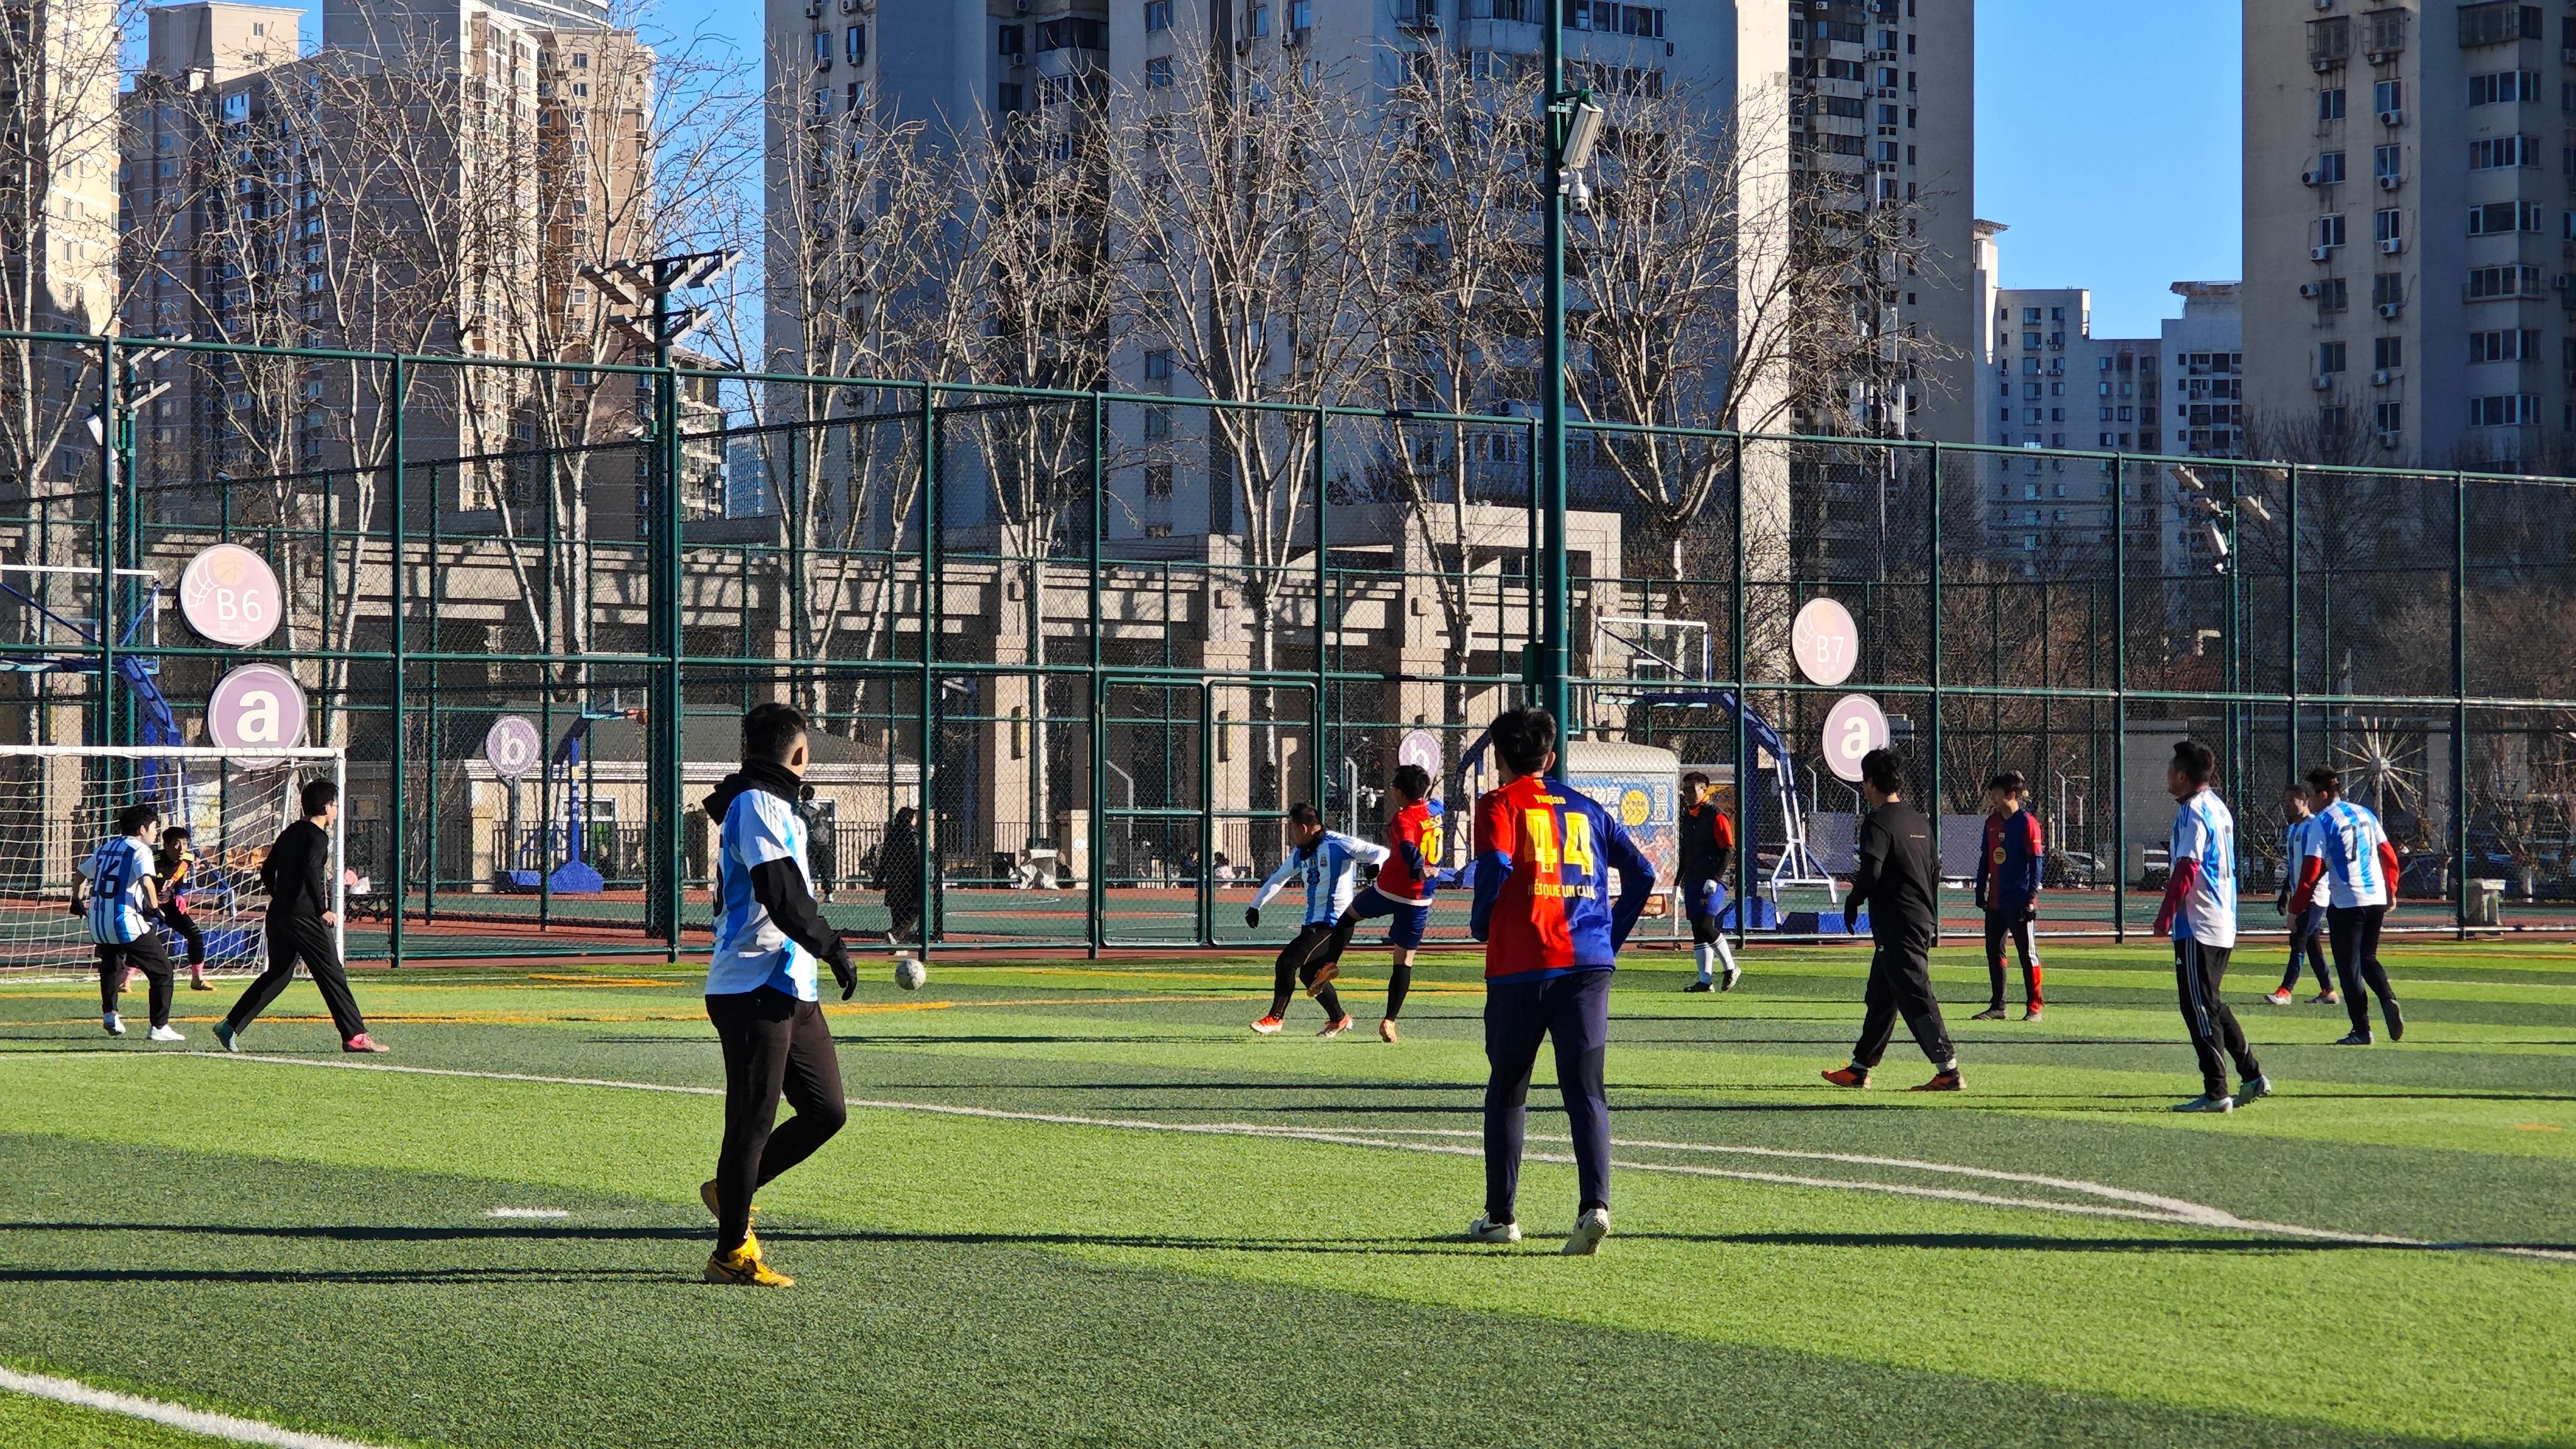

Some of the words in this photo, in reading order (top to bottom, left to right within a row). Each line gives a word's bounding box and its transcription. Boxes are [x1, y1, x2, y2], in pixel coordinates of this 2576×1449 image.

[217, 588, 263, 622] B6
[1817, 635, 1845, 663] B7
[236, 691, 279, 743] a
[501, 727, 526, 765] b
[1841, 716, 1870, 760] a
[1420, 826, 1443, 865] 10
[1524, 808, 1594, 877] 44
[1528, 879, 1542, 896] MÉS
[1543, 884, 1562, 899] QUE
[1562, 886, 1575, 897] UN
